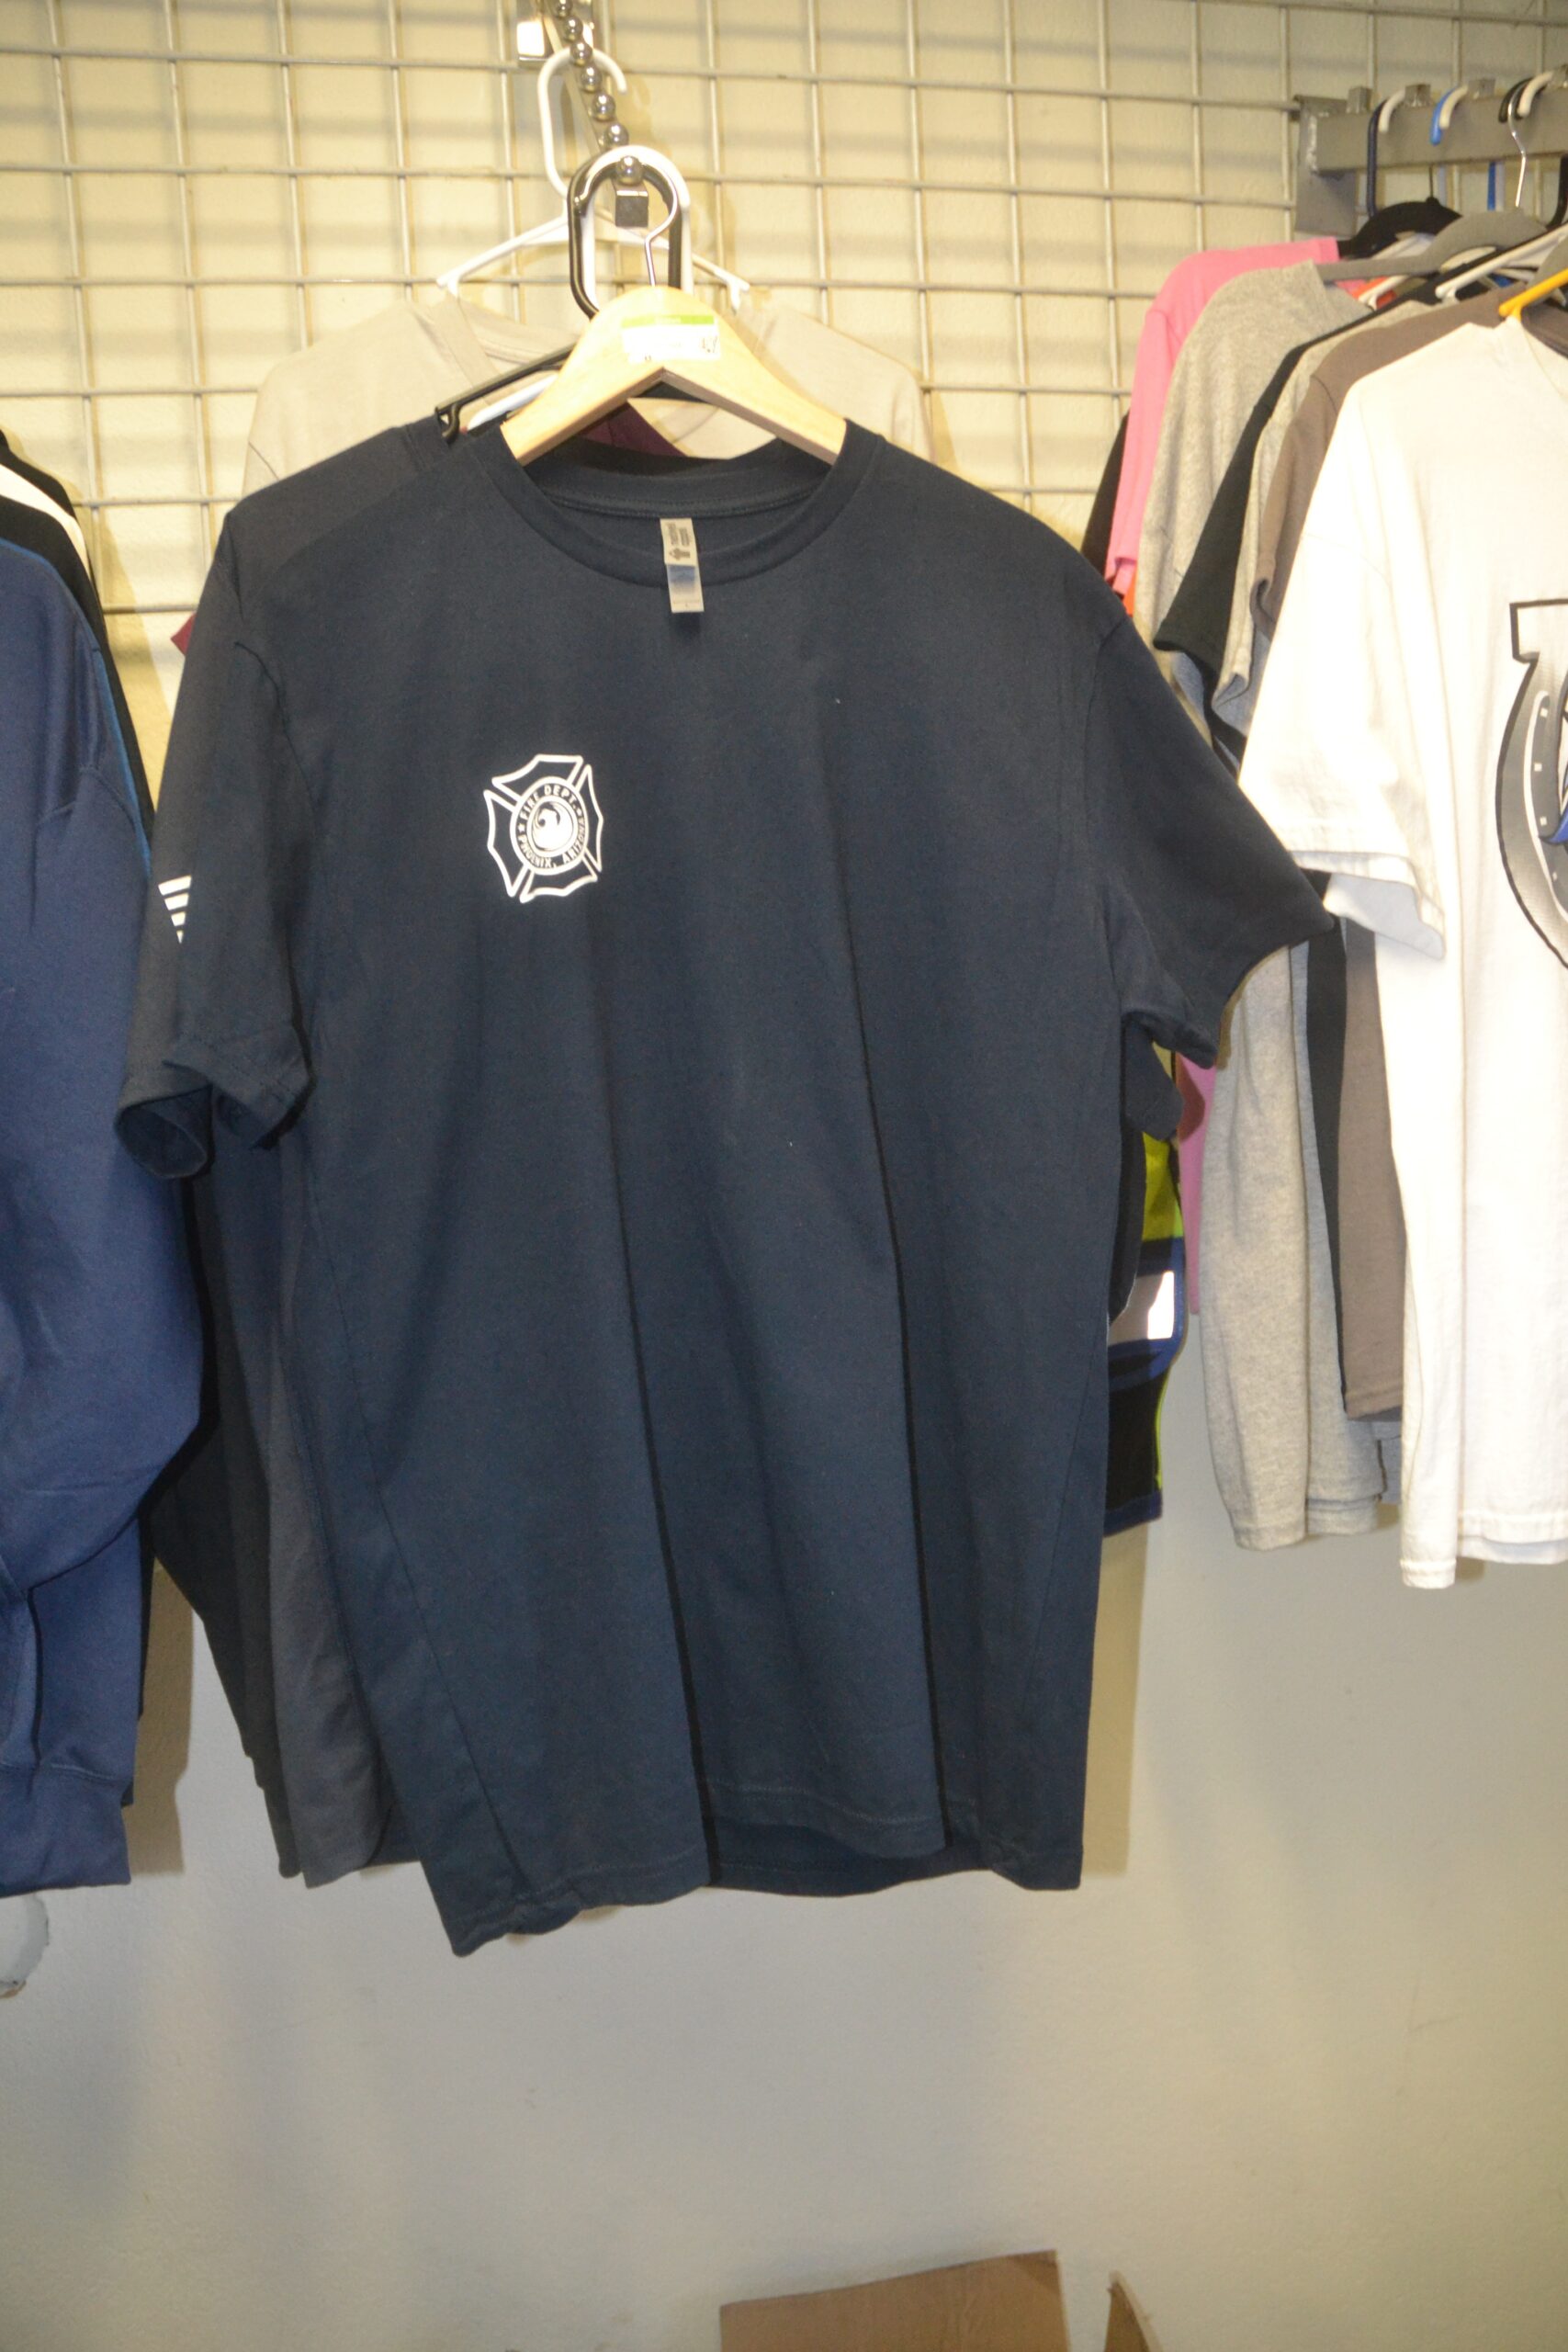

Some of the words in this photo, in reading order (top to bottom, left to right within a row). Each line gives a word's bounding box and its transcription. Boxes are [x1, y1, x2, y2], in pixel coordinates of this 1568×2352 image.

[519, 791, 539, 820] FIRE
[544, 785, 577, 809] DEPT.
[562, 817, 585, 864] ARIZONA
